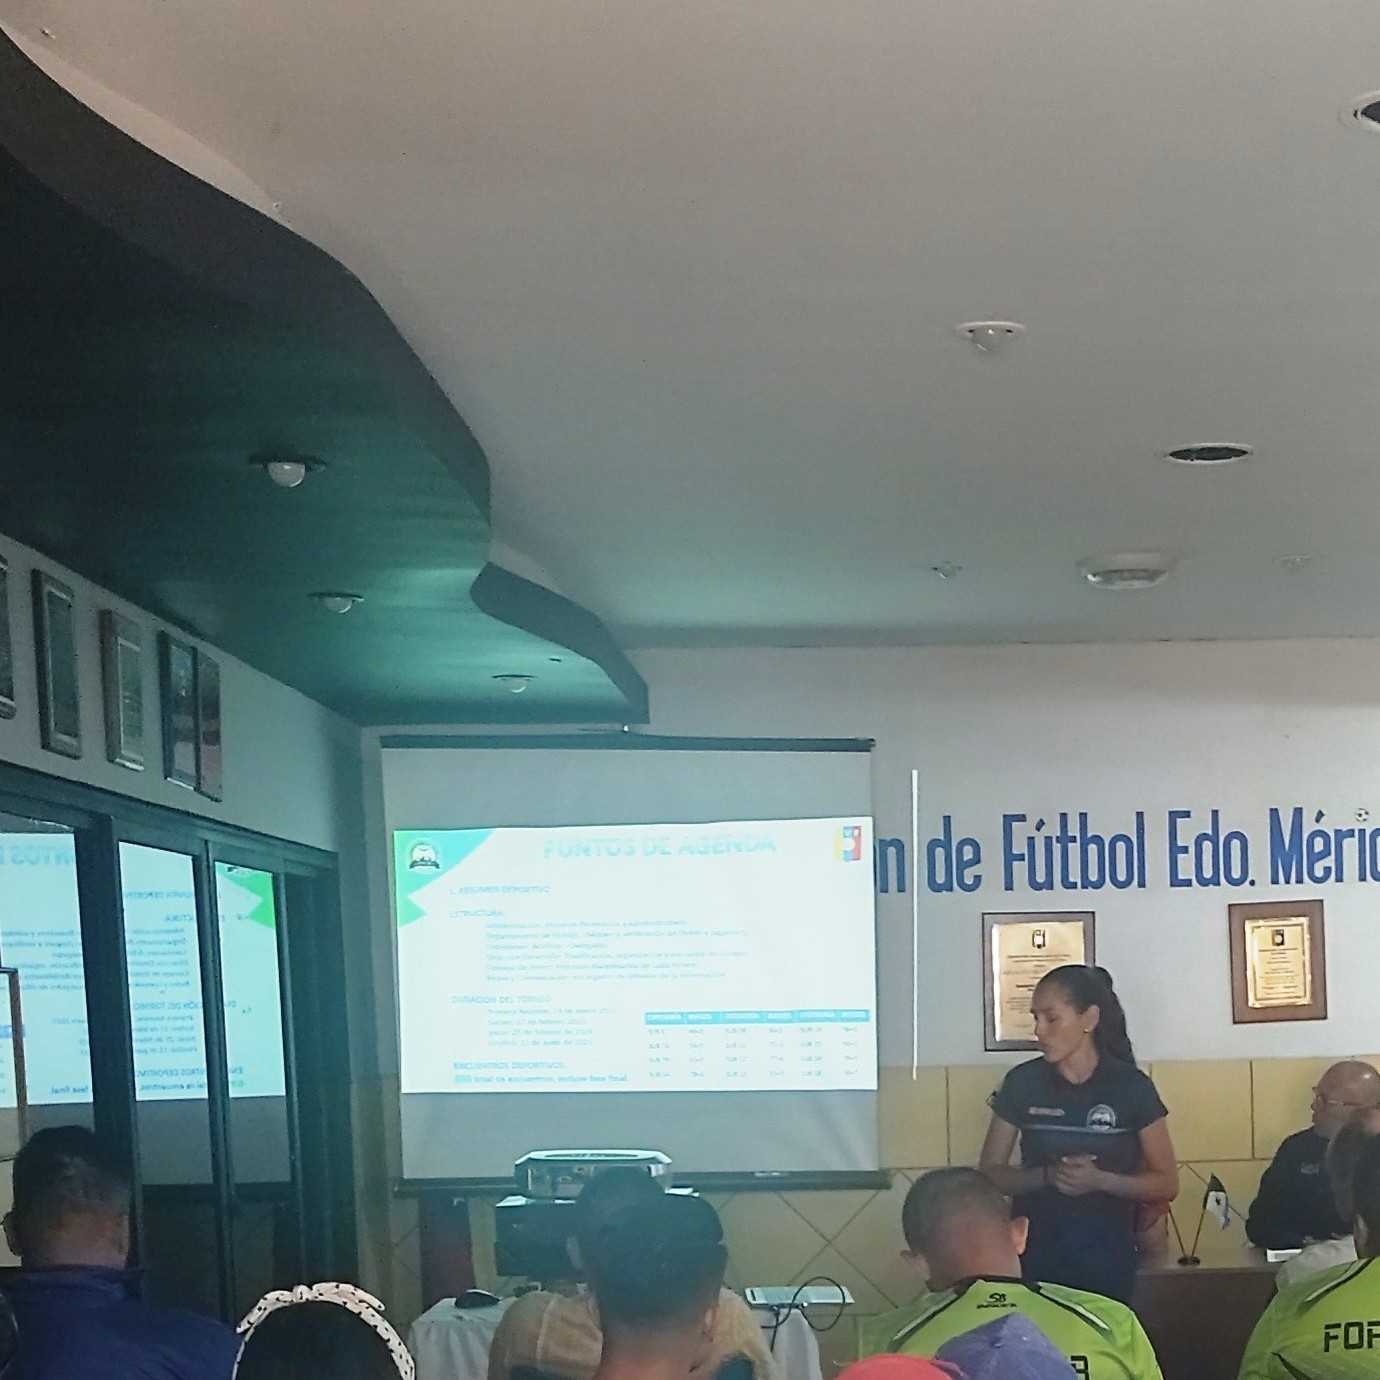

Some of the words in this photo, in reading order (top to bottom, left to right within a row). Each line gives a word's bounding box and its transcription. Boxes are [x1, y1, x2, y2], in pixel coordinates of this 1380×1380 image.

[926, 815, 982, 893] de
[1002, 810, 1147, 892] Fútbol
[1167, 809, 1256, 888] Edo.
